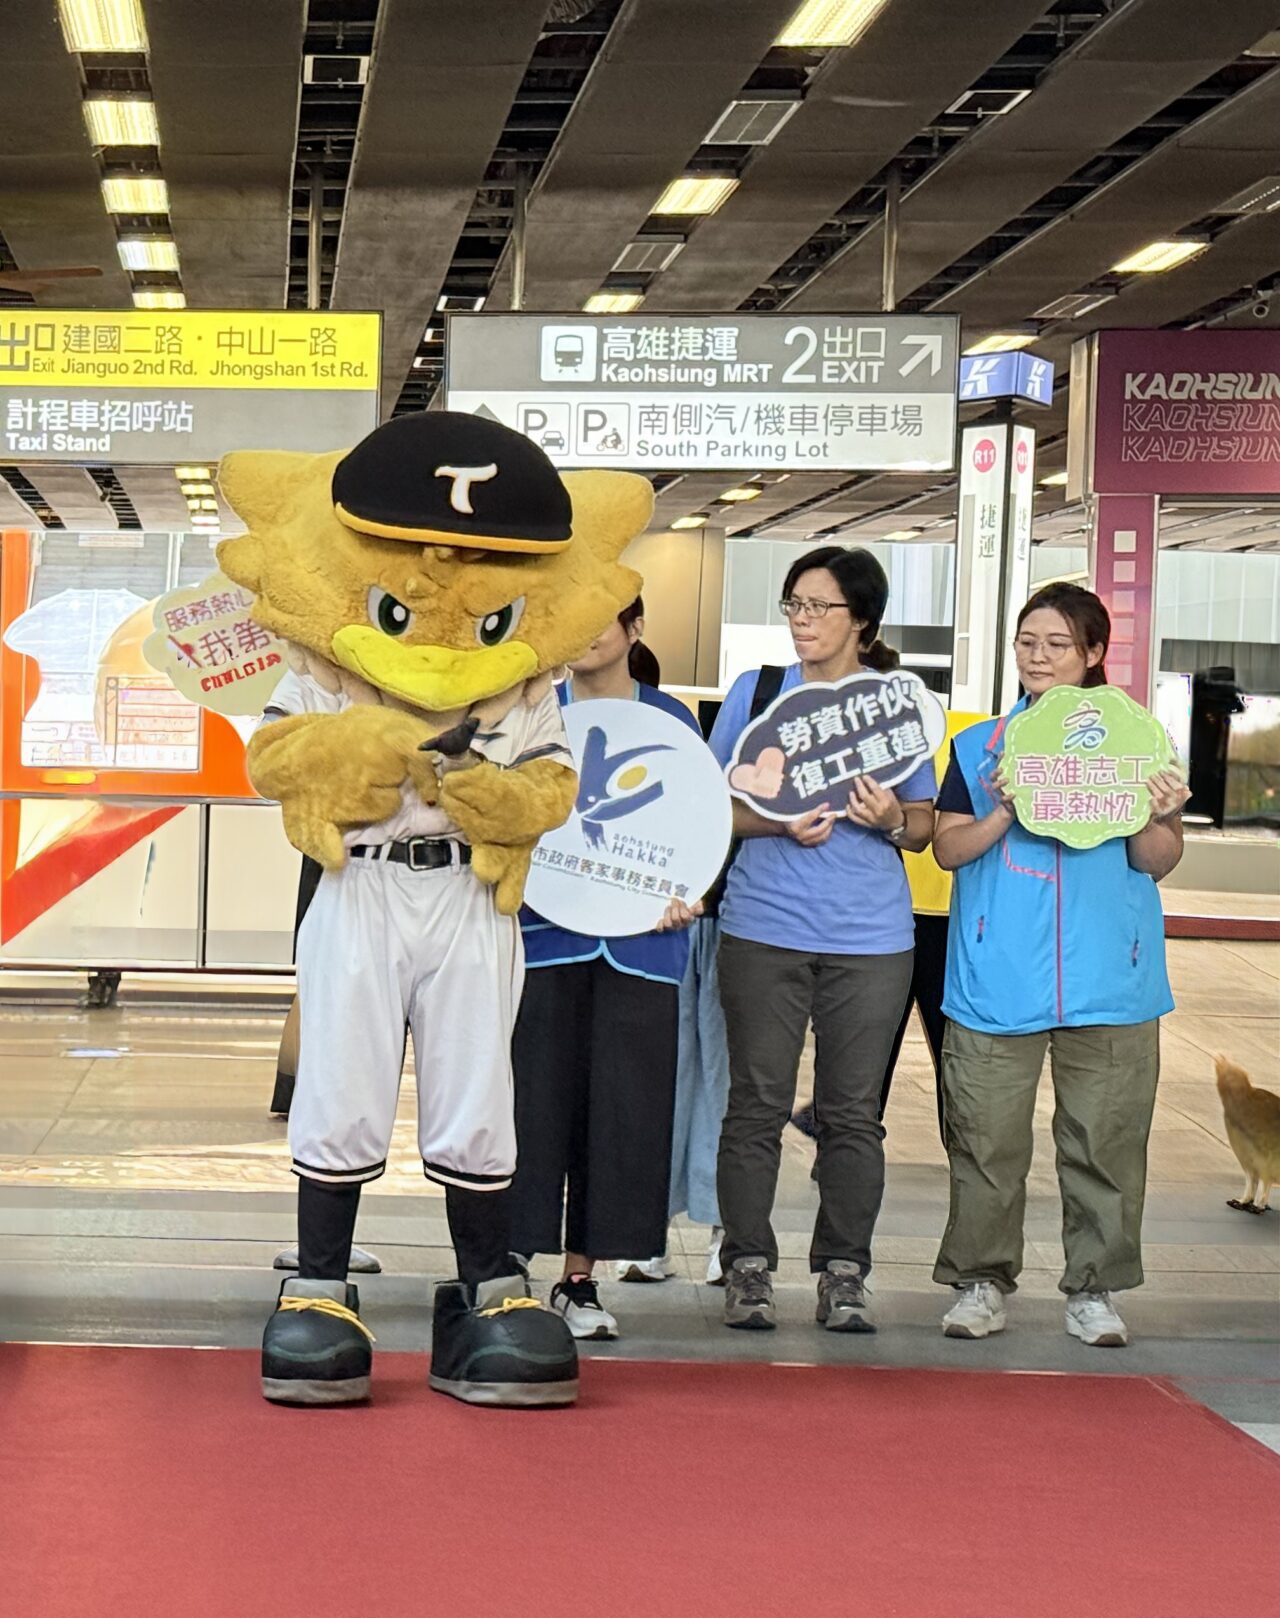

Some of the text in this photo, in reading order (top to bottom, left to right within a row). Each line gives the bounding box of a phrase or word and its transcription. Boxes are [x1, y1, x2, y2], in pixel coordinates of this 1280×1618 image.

[602, 326, 739, 362] 高雄捷運
[782, 325, 818, 384] 2
[822, 326, 886, 358] 出口
[33, 357, 55, 373] Exit
[61, 358, 368, 380] Jianguo 2nd Rd. Jhongshan 1st Rd.
[601, 363, 773, 387] Kaohsiung MRT
[822, 361, 885, 384] EXIT
[6, 399, 194, 433] 計程車招呼站
[637, 403, 923, 437] 南側汽/機車停車場
[6, 434, 111, 452] Taxi Stand
[637, 440, 829, 461] South Parking Lot
[974, 450, 995, 464] R11
[434, 462, 498, 514] T
[198, 618, 279, 667] 我第
[777, 677, 916, 757] 勞資作伙
[789, 720, 930, 799] 復工重建
[1015, 755, 1153, 786] 高雄志工
[1032, 791, 1137, 822] 最熱忱
[611, 841, 667, 867] Hakka
